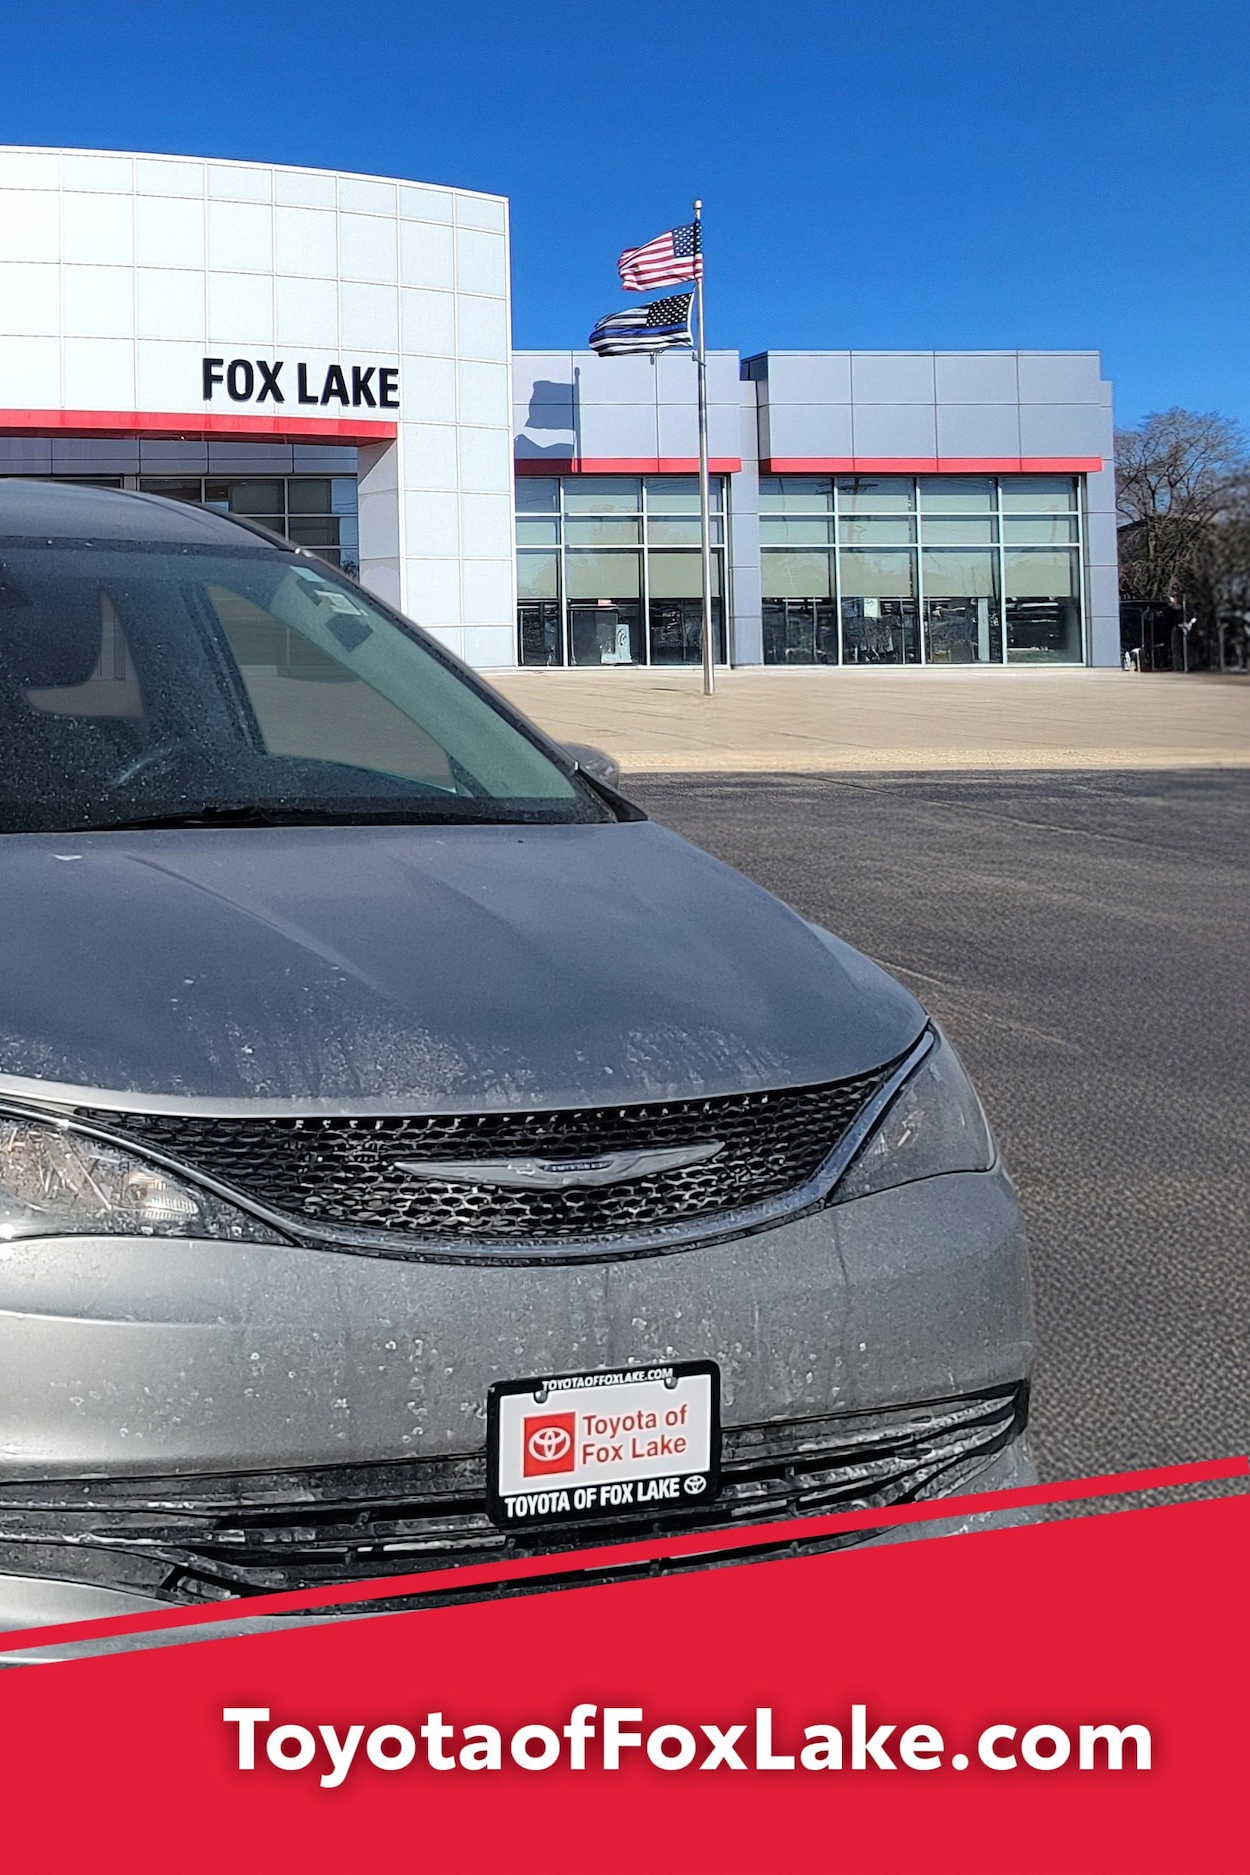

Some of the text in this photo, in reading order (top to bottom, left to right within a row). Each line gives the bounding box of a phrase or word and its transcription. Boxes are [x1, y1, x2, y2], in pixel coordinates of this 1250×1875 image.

[202, 358, 400, 408] FOX LAKE
[542, 1368, 673, 1392] TOYOTAOFFOXLAKE.COM
[583, 1404, 688, 1438] Toyota of
[582, 1435, 686, 1465] Fox Lake
[505, 1477, 680, 1518] TOYOTA OF FOX LAKE
